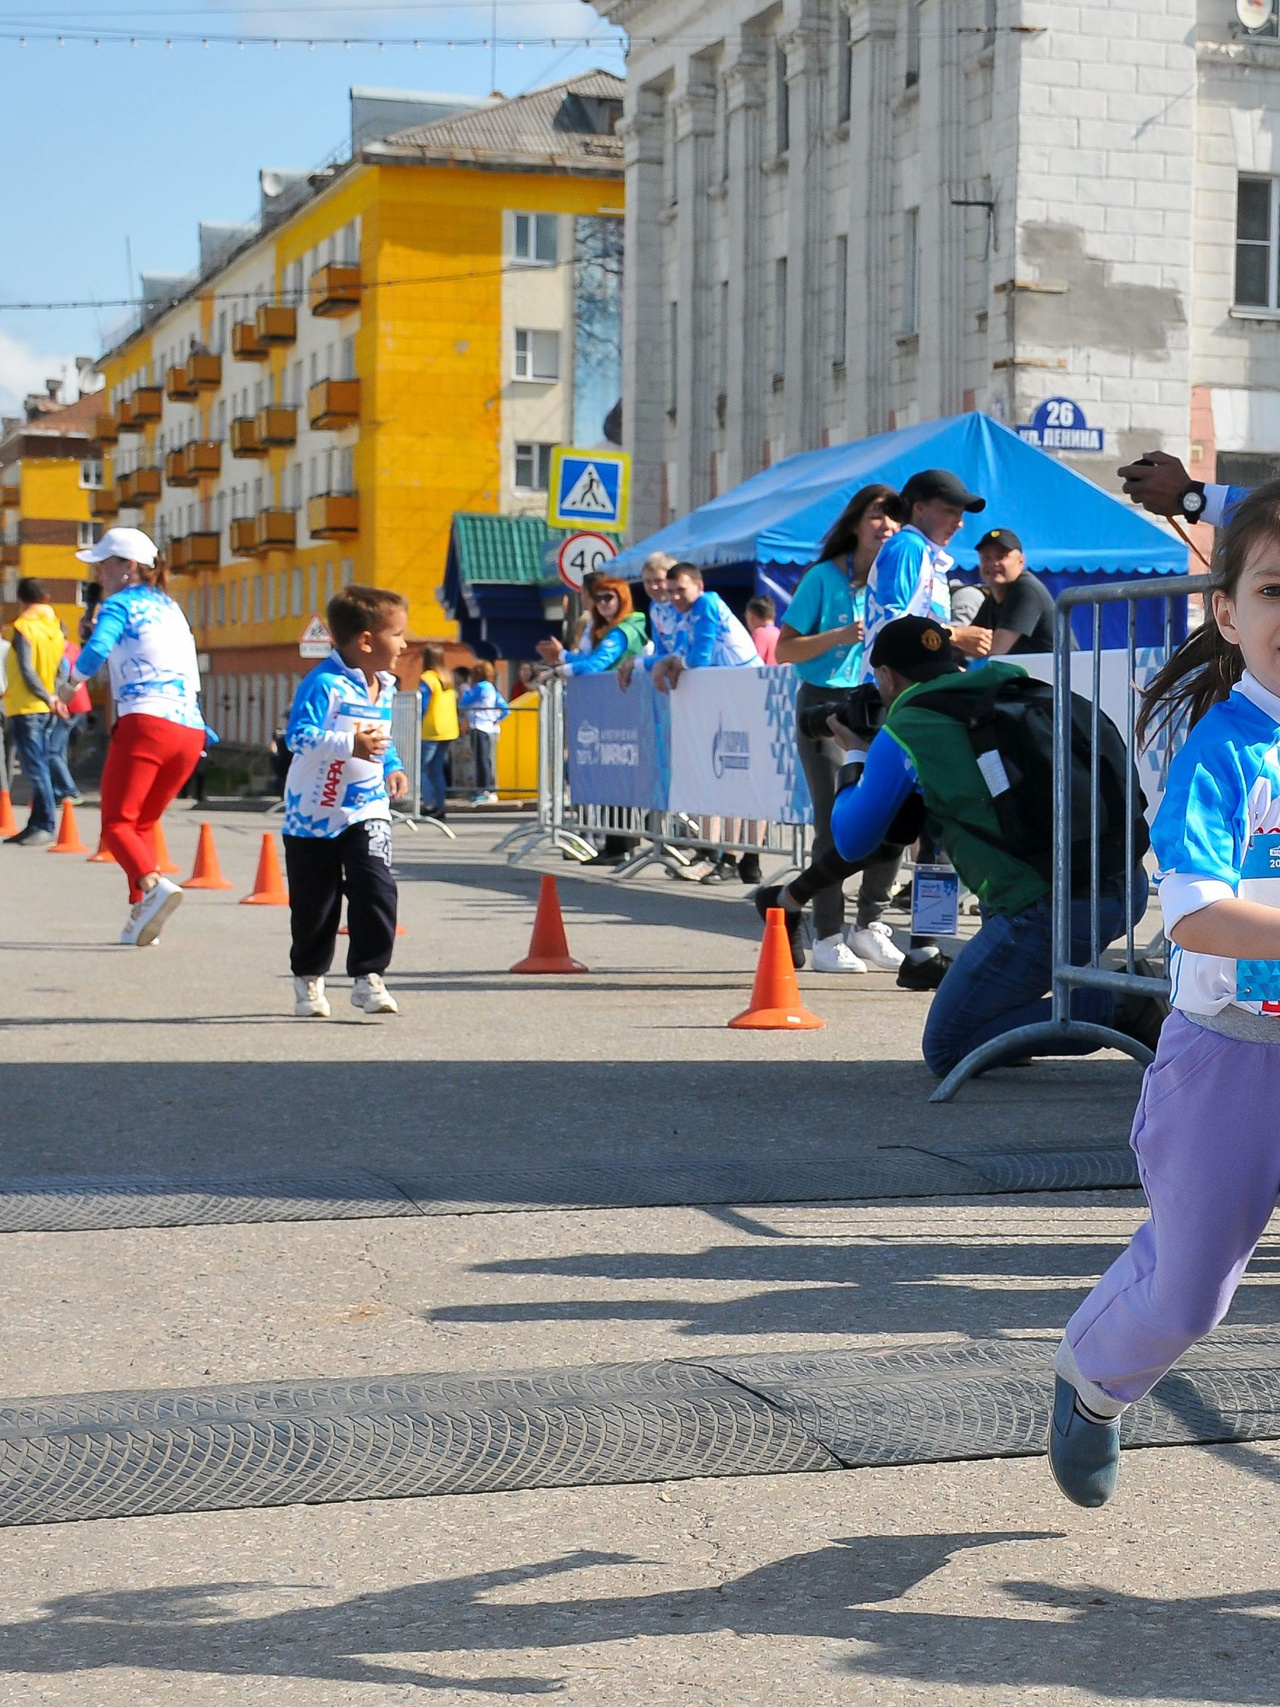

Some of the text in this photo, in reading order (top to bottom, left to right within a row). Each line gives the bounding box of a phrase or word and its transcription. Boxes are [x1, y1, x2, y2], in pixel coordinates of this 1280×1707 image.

[1046, 400, 1075, 427] 26
[1043, 427, 1100, 449] ЛЕНИНА
[570, 550, 607, 572] 40
[319, 758, 346, 808] МАРА
